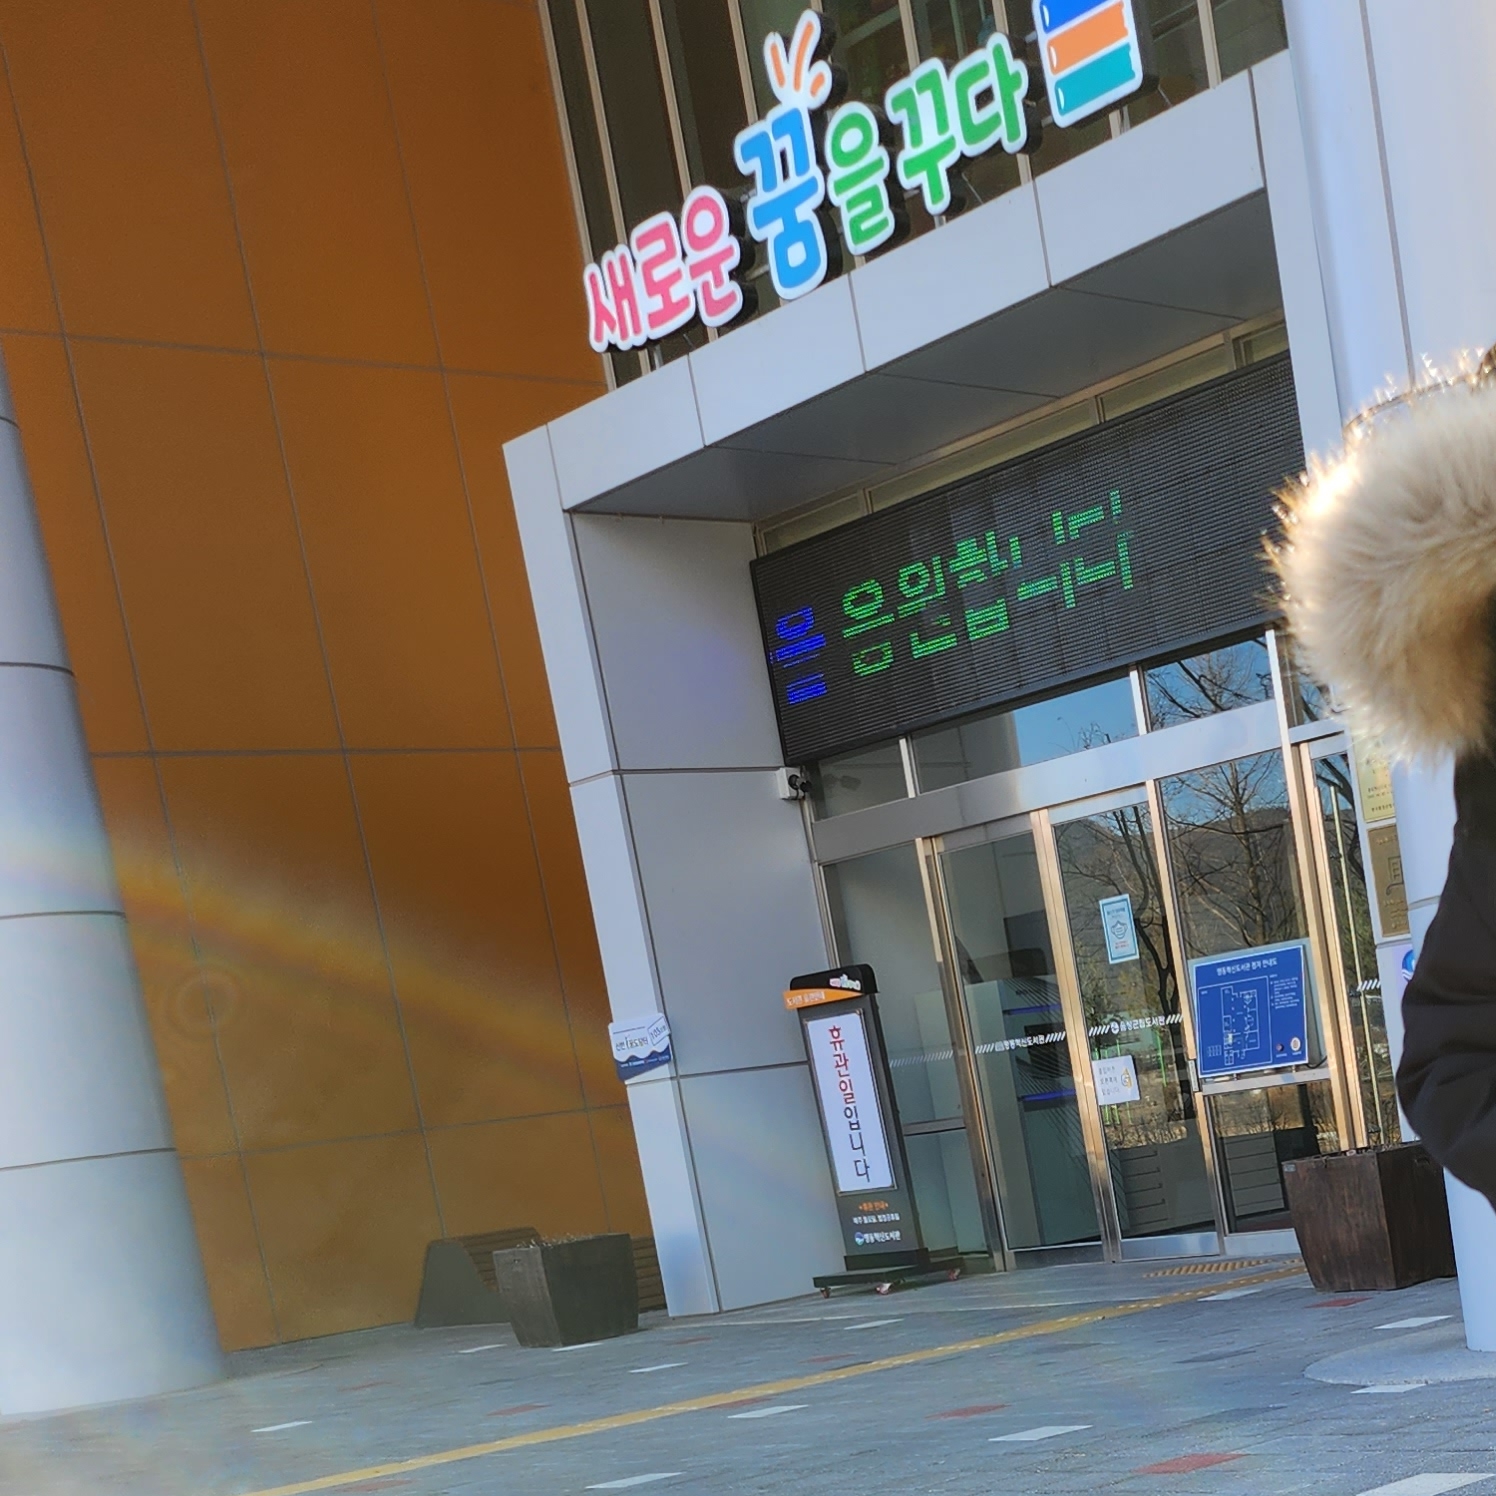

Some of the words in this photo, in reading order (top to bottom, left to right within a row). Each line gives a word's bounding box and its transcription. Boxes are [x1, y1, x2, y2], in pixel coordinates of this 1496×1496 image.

[585, 186, 742, 352] 새로운
[735, 104, 895, 299] 꿈을
[887, 34, 1028, 214] 꾸다
[828, 1025, 871, 1184] 휴관일입니다
